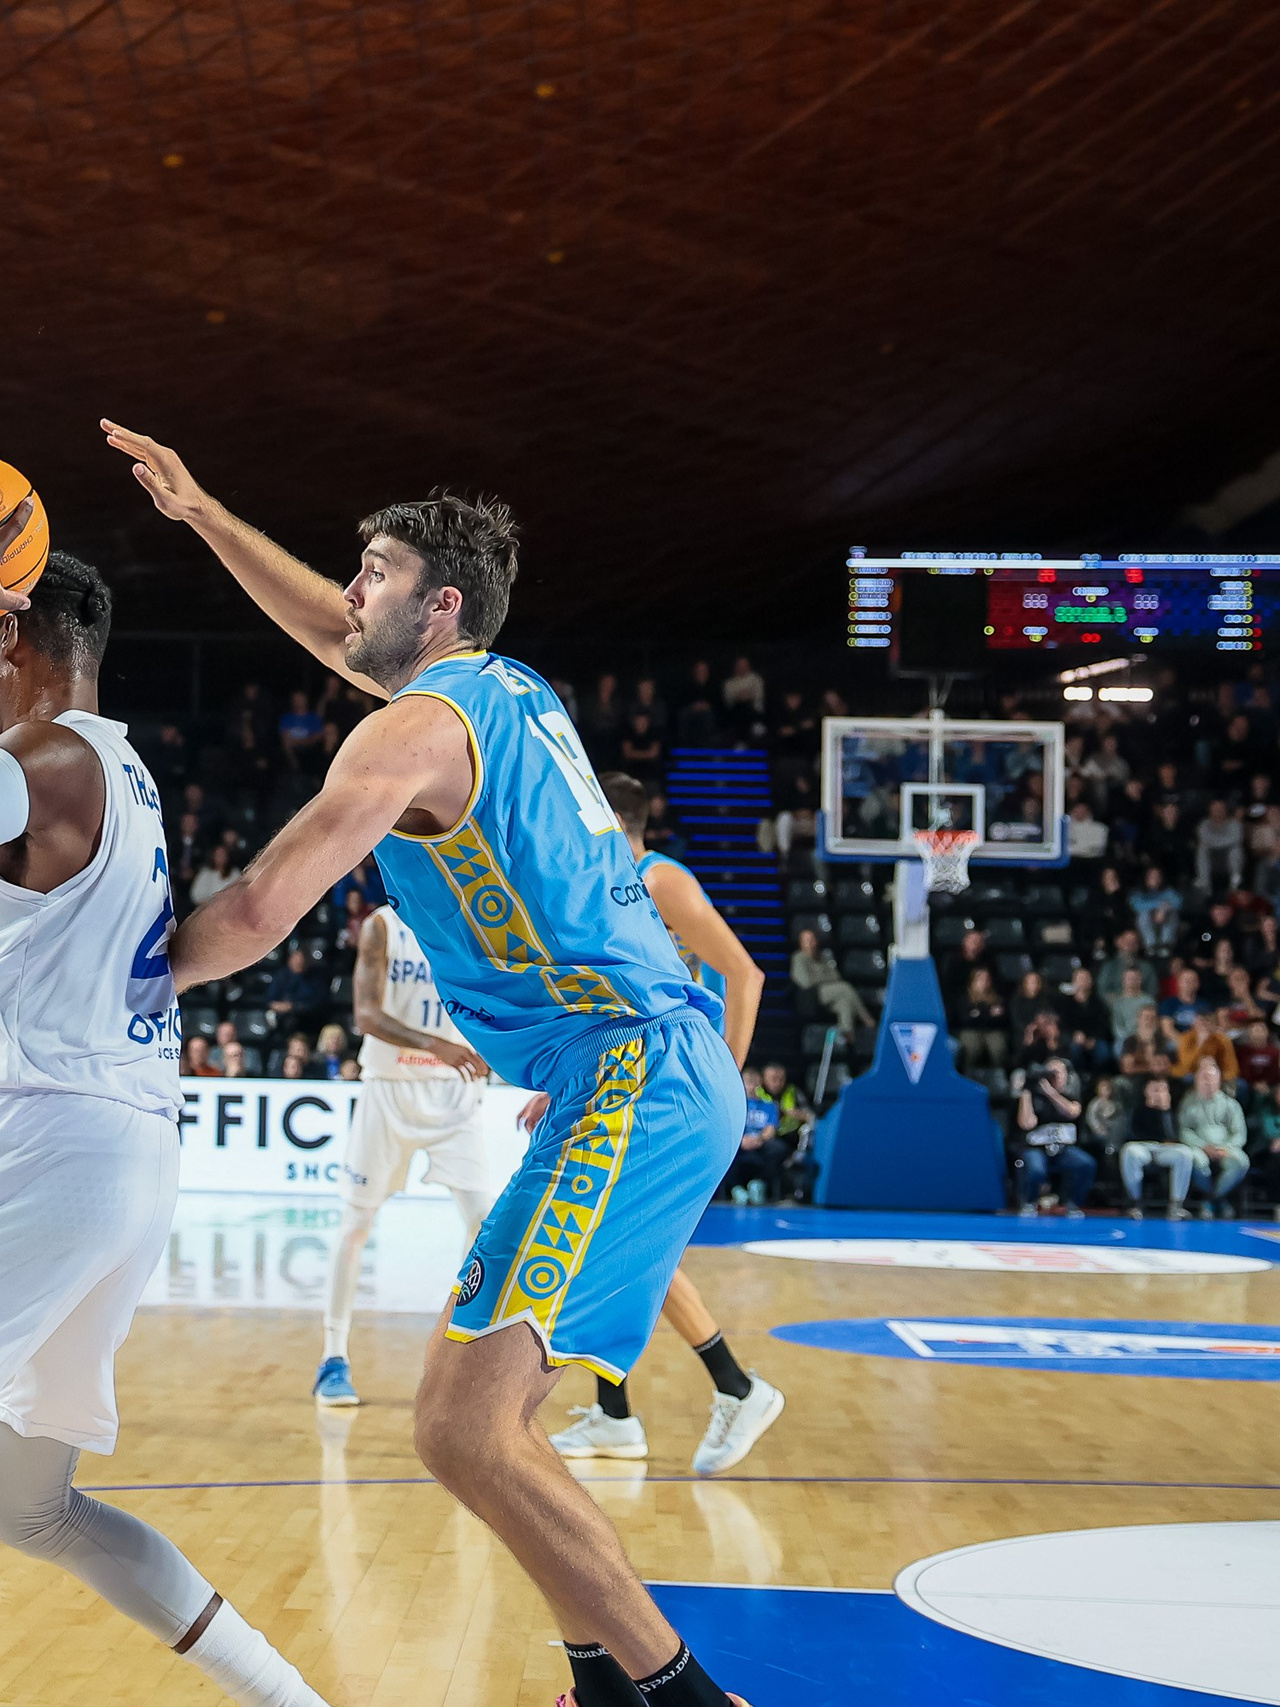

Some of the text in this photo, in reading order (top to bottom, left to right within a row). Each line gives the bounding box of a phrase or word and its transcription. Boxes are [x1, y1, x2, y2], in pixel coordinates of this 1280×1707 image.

[391, 959, 434, 984] SPA
[422, 999, 443, 1028] 11
[179, 1094, 356, 1150] FFIC
